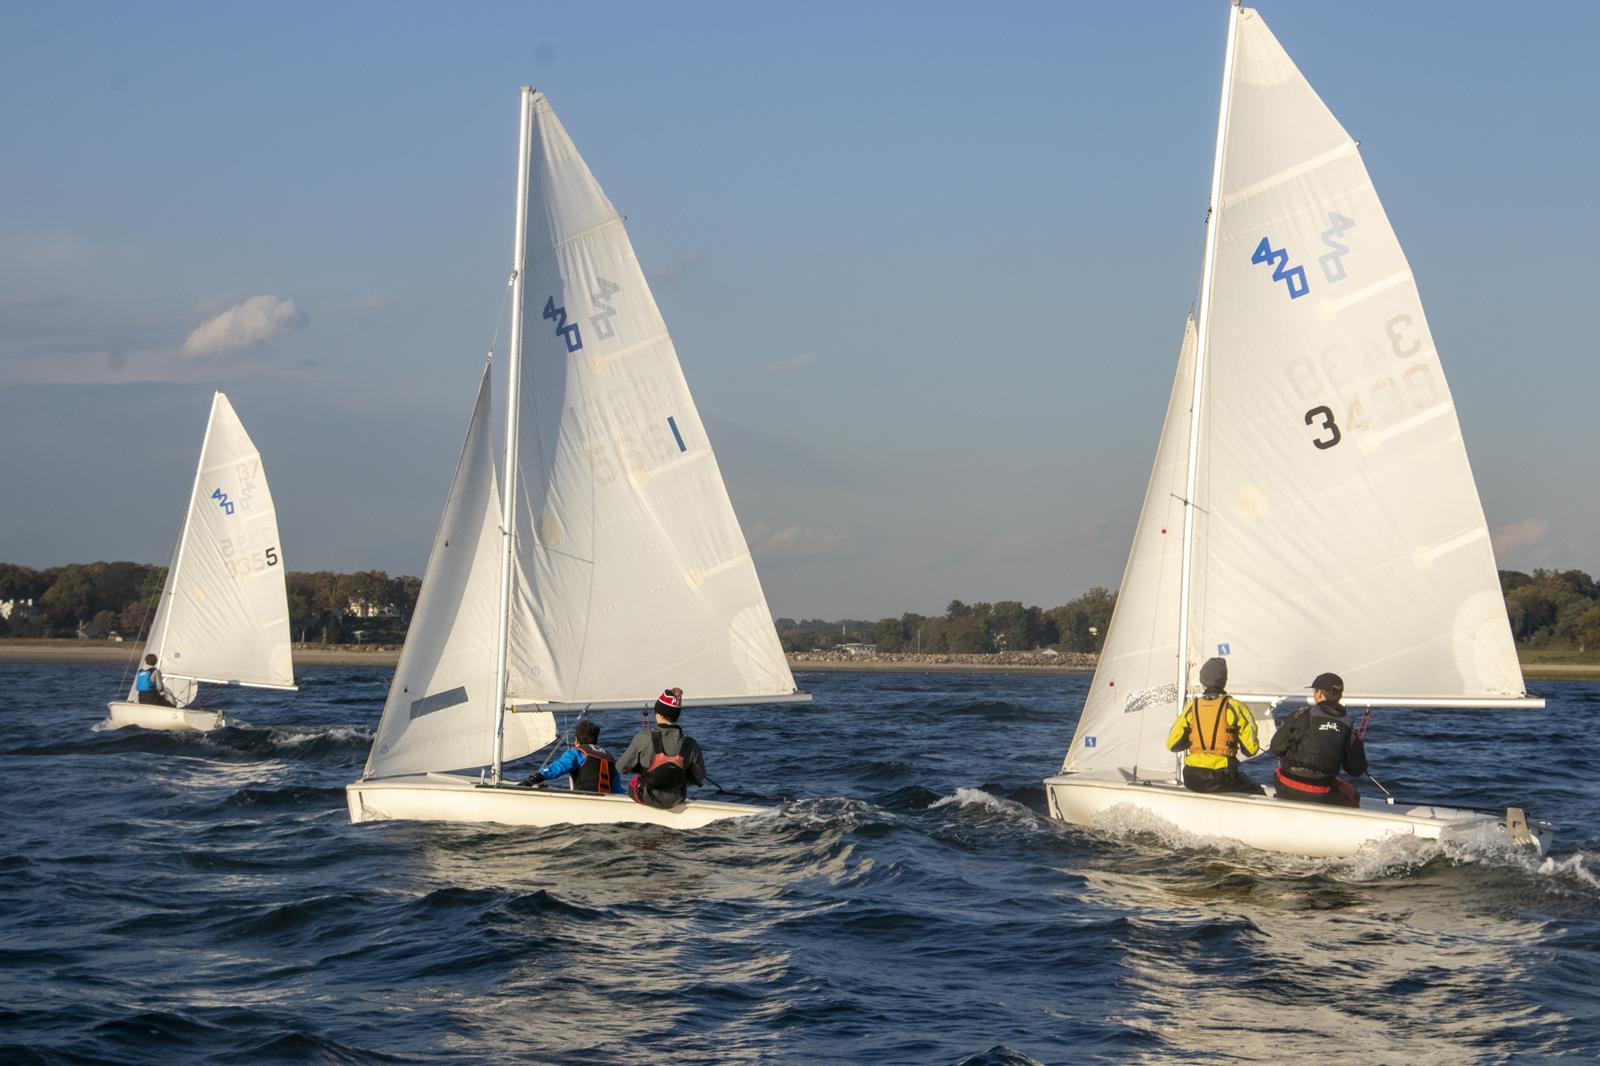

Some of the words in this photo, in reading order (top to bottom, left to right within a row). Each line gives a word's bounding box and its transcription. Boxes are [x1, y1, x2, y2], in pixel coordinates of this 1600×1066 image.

[1250, 236, 1310, 300] 420
[543, 296, 583, 353] 420
[1304, 405, 1342, 450] 3
[211, 488, 234, 515] 420
[265, 546, 278, 567] 5
